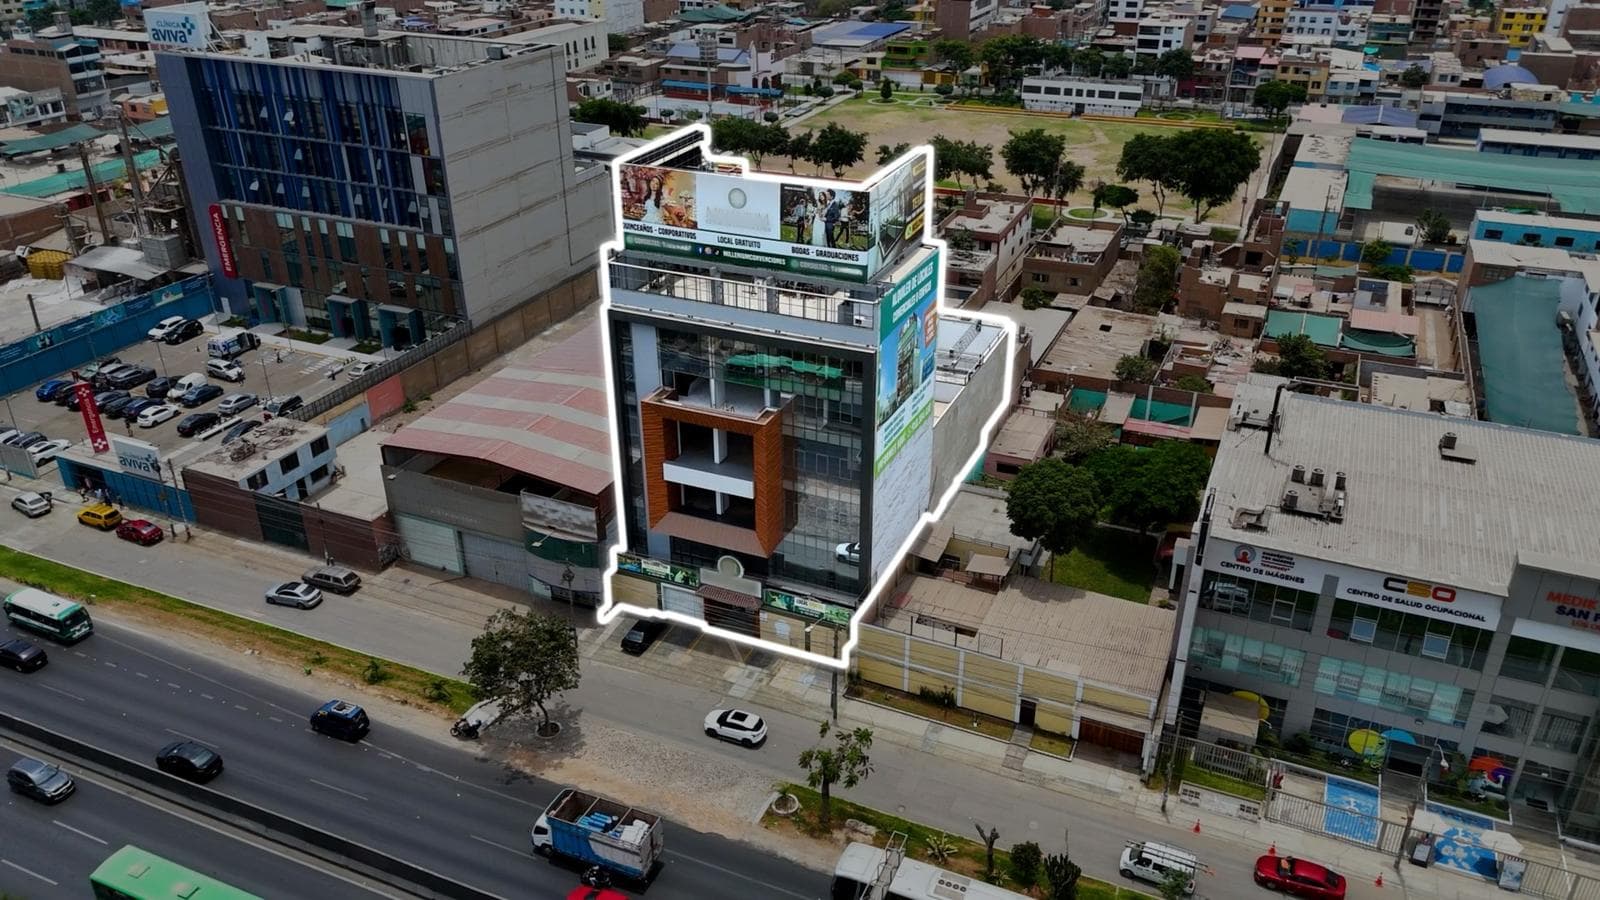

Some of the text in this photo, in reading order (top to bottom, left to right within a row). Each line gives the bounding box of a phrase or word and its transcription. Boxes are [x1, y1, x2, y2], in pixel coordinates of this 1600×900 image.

[151, 28, 188, 43] aviva
[213, 211, 232, 272] EMERGENCIA
[658, 227, 697, 240] CORPORATIVOS
[717, 235, 761, 249] LOCAL GRATUITO
[791, 246, 810, 256] BODAS
[815, 249, 859, 262] GRADUACIONES
[119, 456, 151, 472] aviva
[1220, 561, 1305, 584] CENTRO DE IMÁGENES
[1383, 576, 1456, 603] CSO
[1346, 587, 1486, 622] CENTRO DE SALUD OCUPACIONAL
[1556, 605, 1590, 620] SAN
